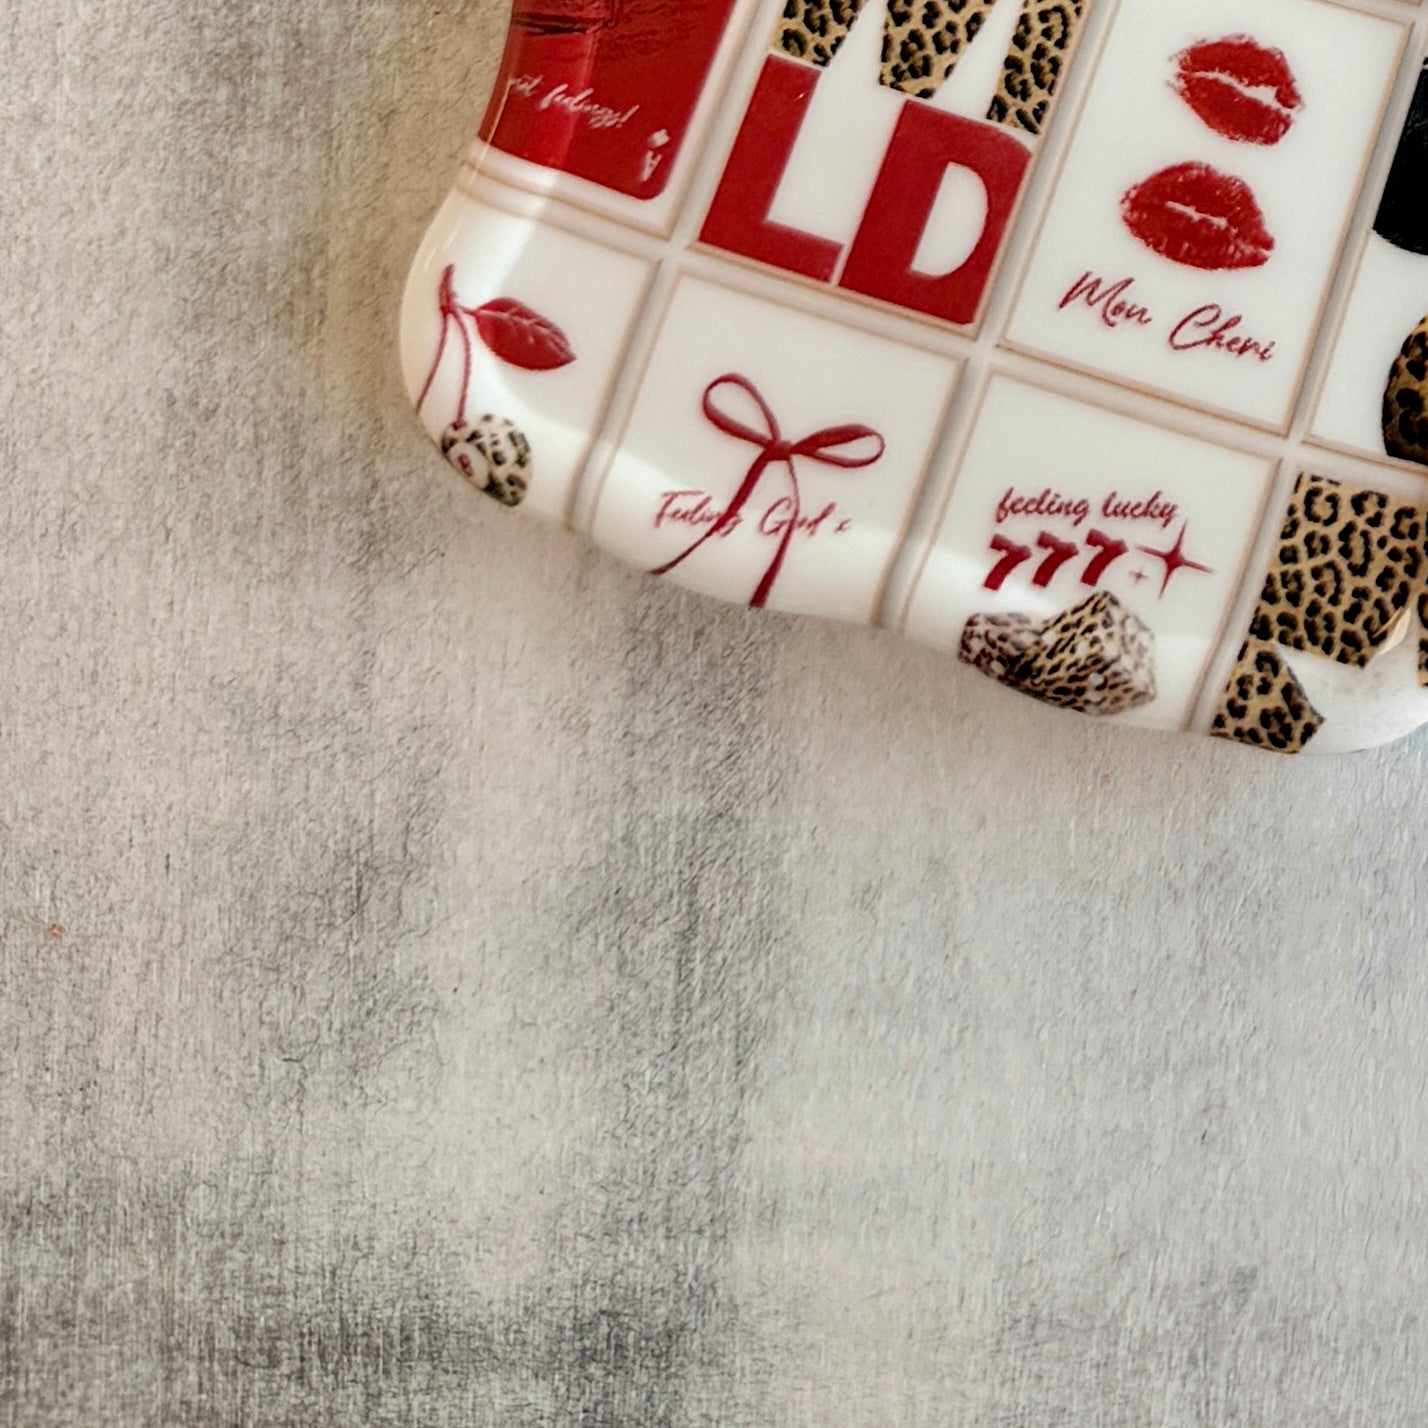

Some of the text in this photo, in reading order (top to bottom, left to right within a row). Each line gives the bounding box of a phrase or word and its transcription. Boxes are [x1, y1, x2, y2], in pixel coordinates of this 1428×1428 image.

[1058, 270, 1277, 363] Mon Cheri
[995, 486, 1179, 529] feeling lucky
[982, 528, 1129, 592] 777
